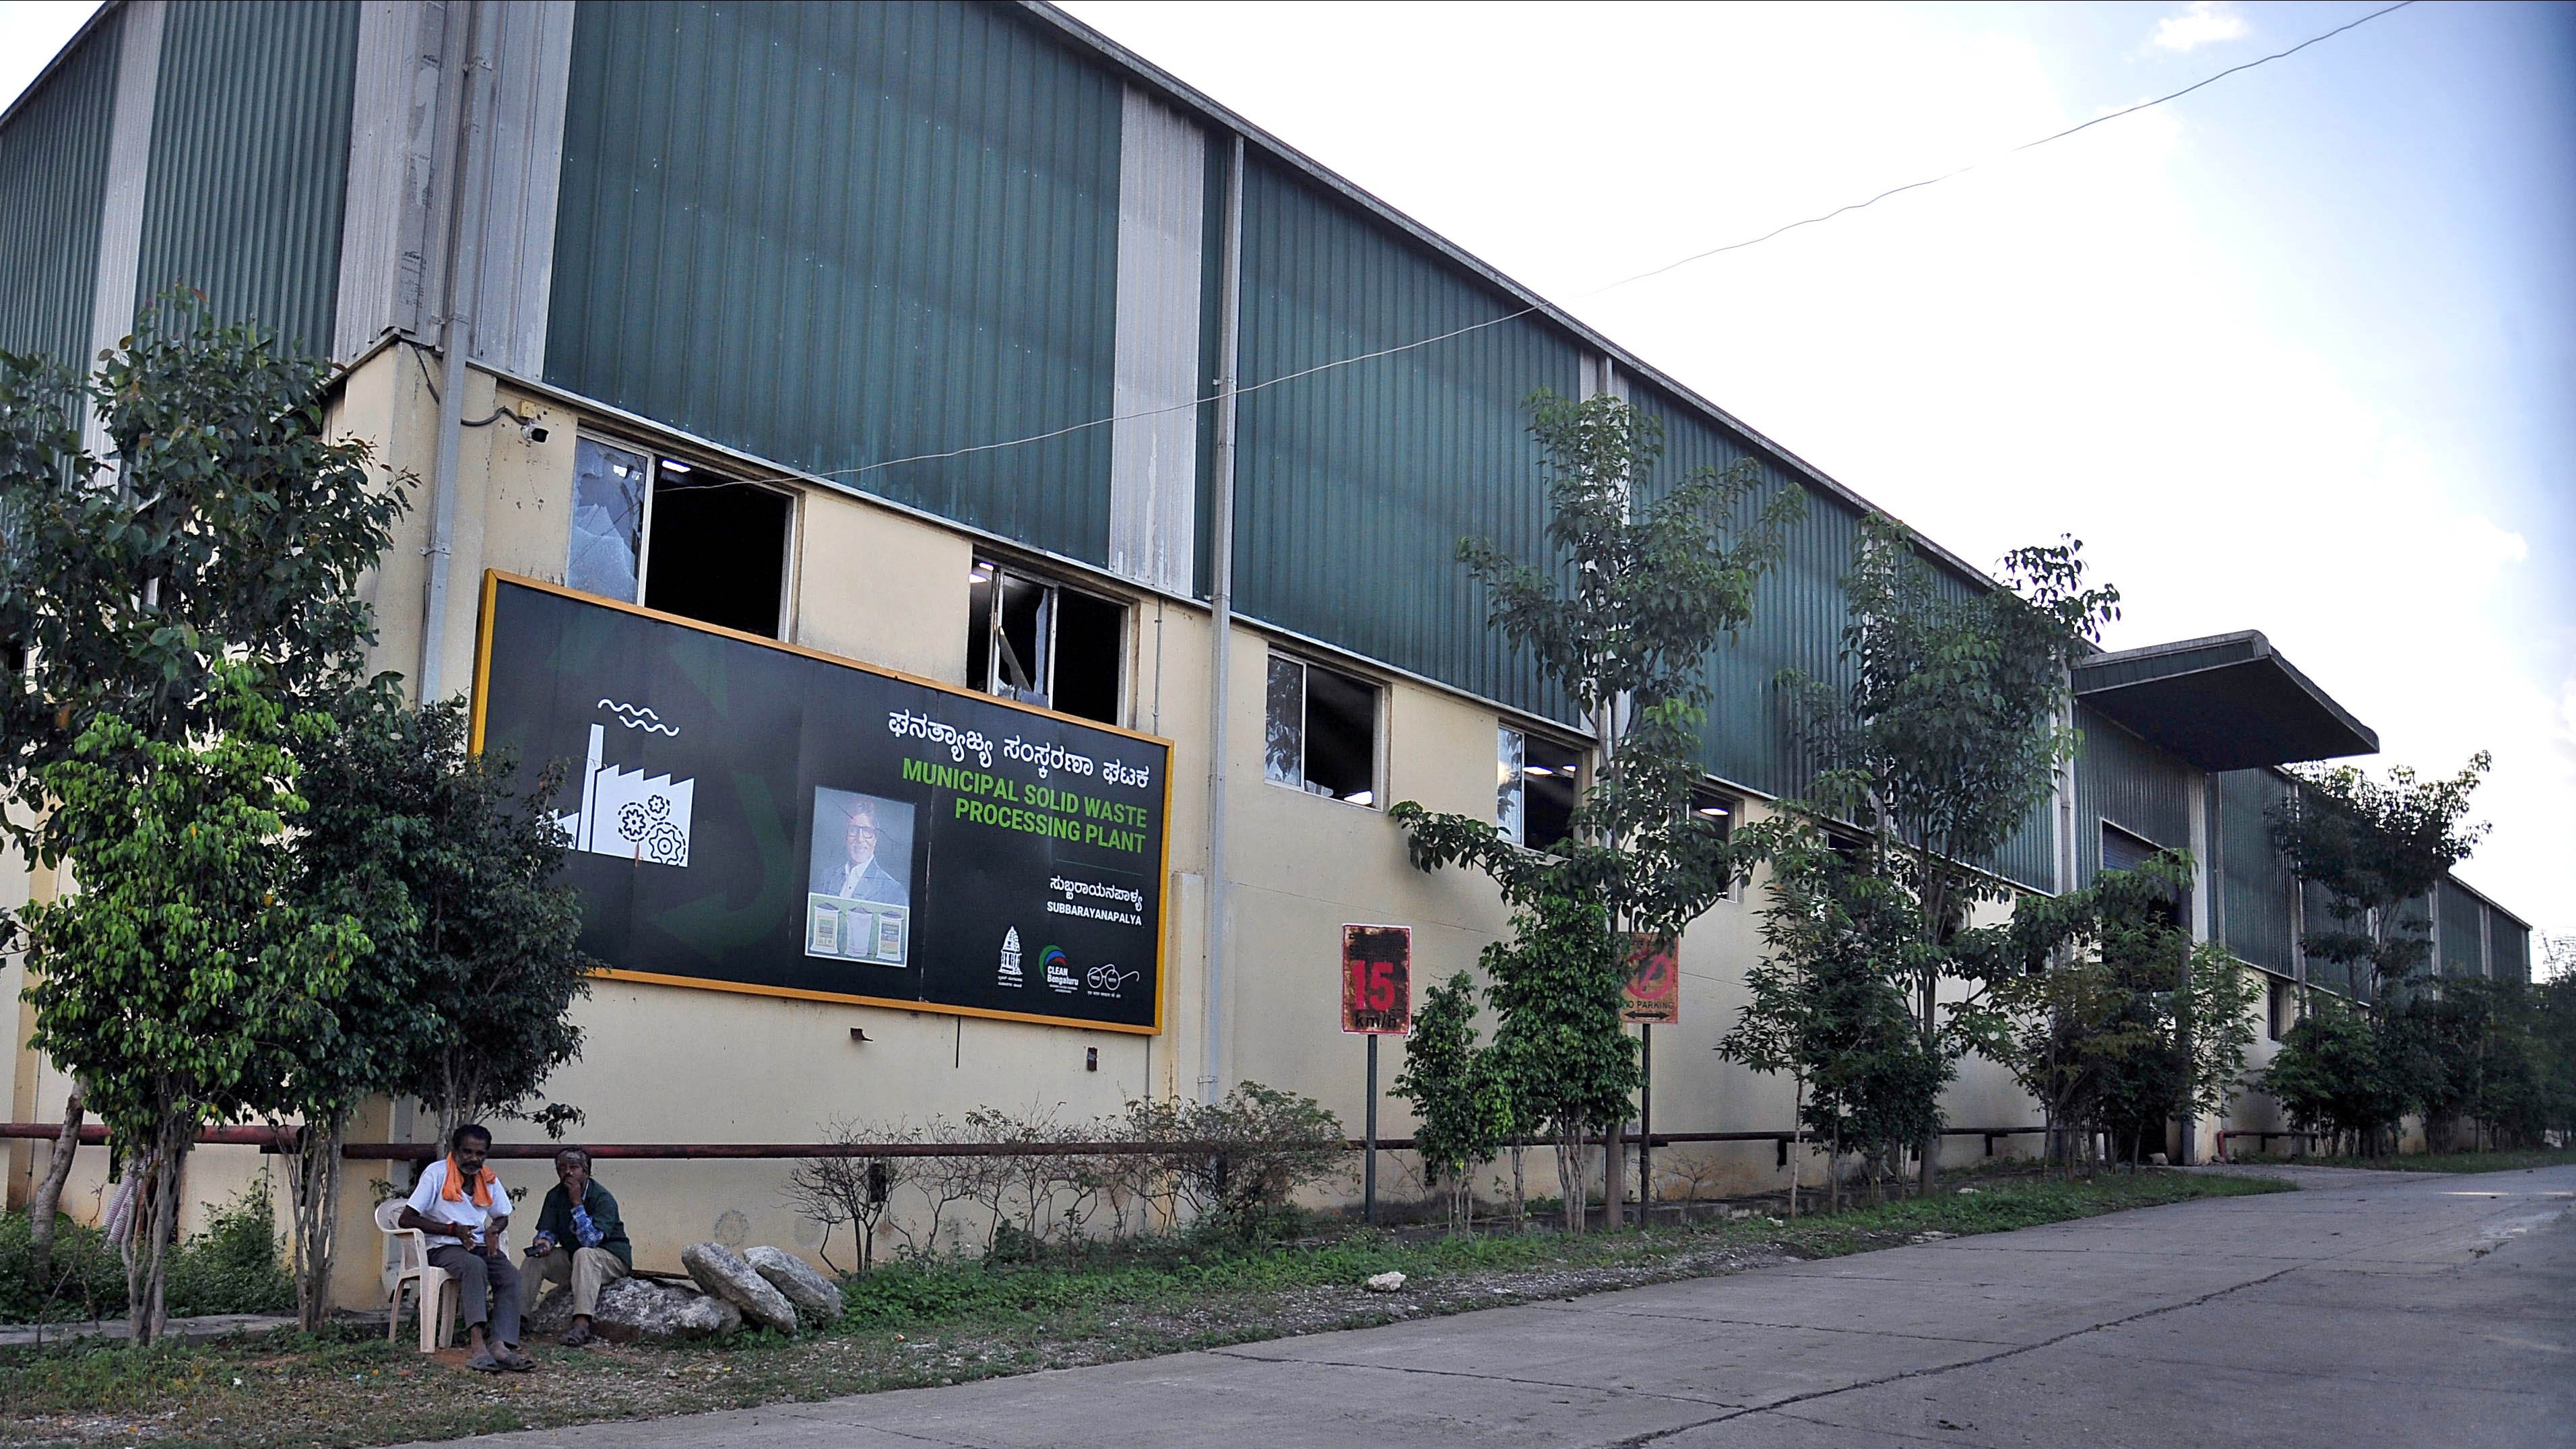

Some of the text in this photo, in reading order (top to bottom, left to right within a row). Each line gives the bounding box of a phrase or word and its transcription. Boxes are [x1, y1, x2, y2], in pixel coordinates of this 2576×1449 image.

[889, 709, 1149, 788] ಘನತ್ಯಾಜ್ಯ ಸಂಸ್ಕರಣಾ ಘಟಕ
[902, 757, 1147, 829] MUNICIPAL SOLID WASTE
[955, 798, 1146, 854] PROCESSING PLANT
[1050, 875, 1143, 911] ಸುಬ್ಬರಾಯನಪಾಳ್ಯ
[1047, 901, 1142, 926] SUBBARAYANAPALYA
[1047, 974, 1079, 986] Bengaluru
[1048, 965, 1068, 976] CLEAN
[1351, 960, 1394, 1010] 15
[1355, 1012, 1397, 1028] km/h
[1637, 1000, 1674, 1010] PARKING
